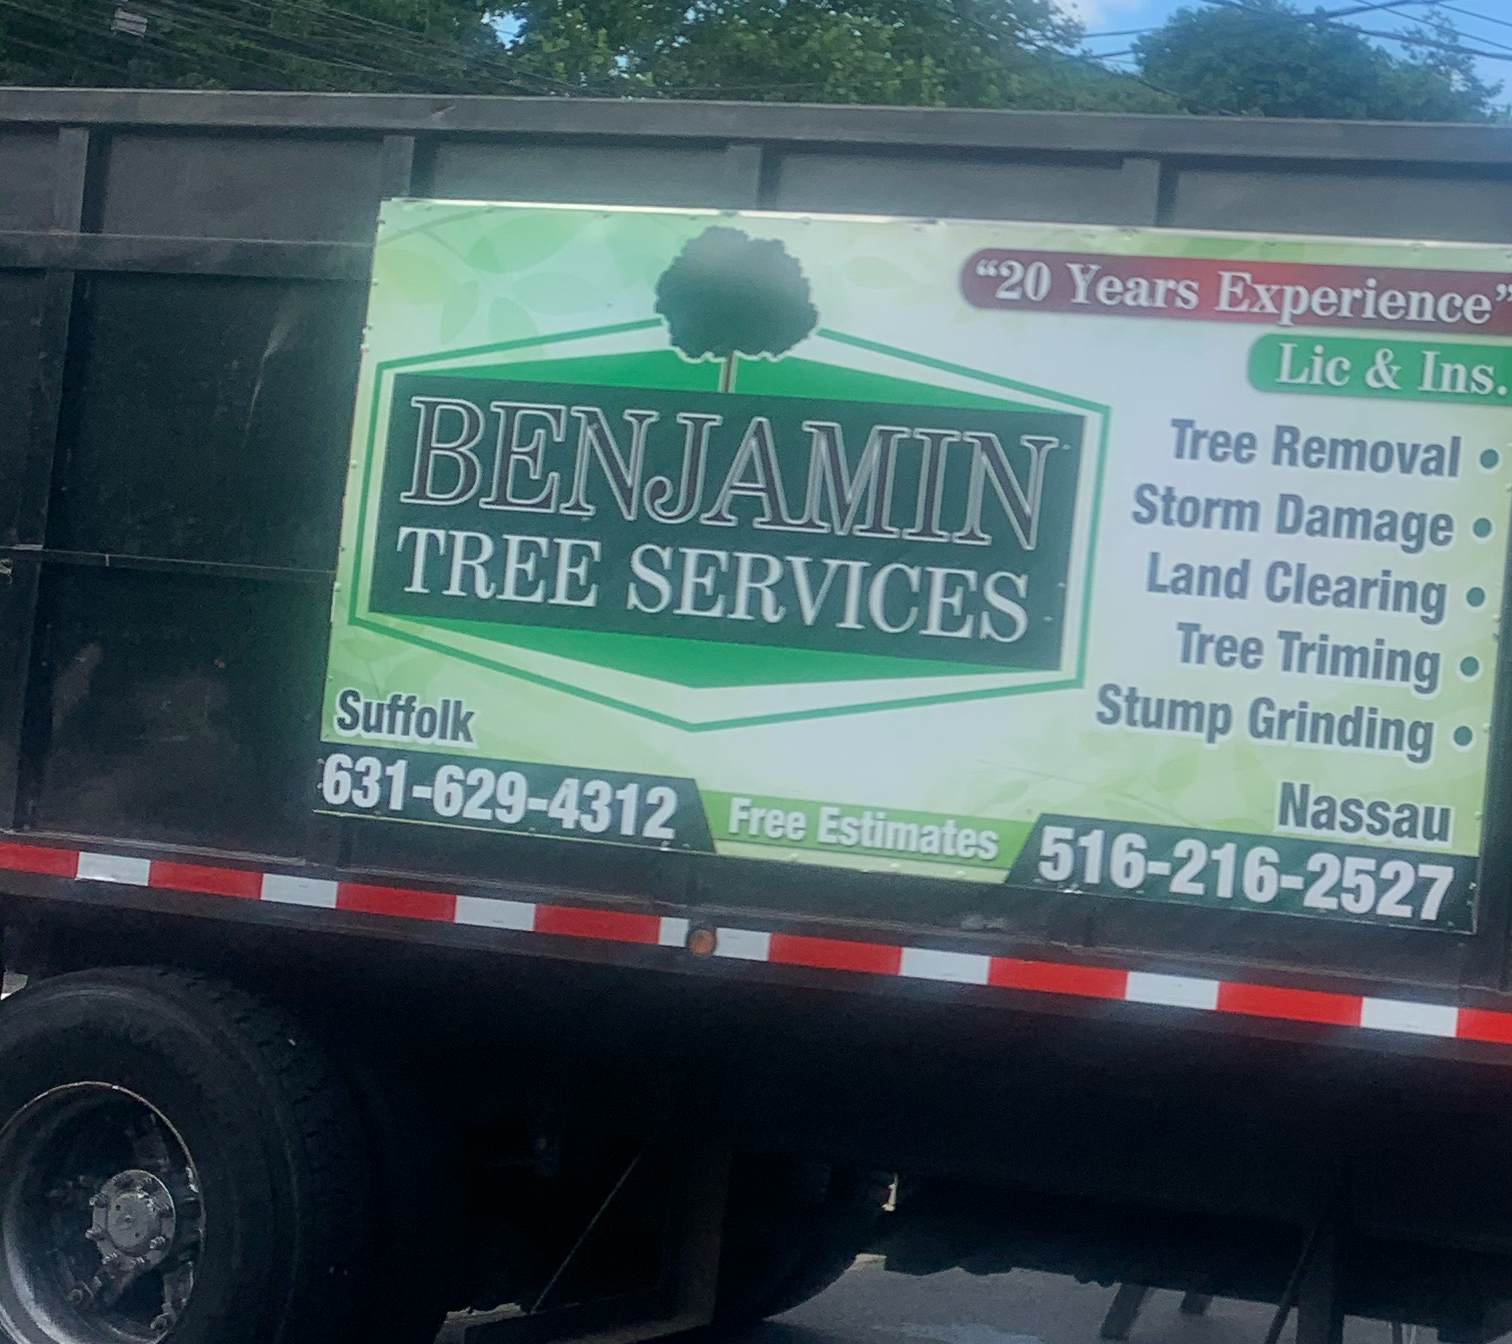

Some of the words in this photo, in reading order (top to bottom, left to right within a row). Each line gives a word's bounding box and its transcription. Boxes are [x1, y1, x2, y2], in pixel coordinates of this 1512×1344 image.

[1066, 262, 1200, 311] Years
[1275, 342, 1351, 387] Lic
[1365, 347, 1403, 390] &
[1417, 350, 1508, 396] Ins.
[399, 395, 1060, 550] BENJAMIN
[1170, 418, 1257, 463] Tree
[1271, 424, 1462, 478] Removal
[1132, 483, 1260, 533] Storm
[1276, 492, 1454, 554] Damage
[396, 525, 600, 608] TREE
[626, 543, 1029, 644] SERVICES
[1146, 551, 1249, 599] Land
[1264, 560, 1447, 624] Clearing
[1176, 622, 1263, 670] Tree
[1277, 629, 1441, 692] Triming
[335, 688, 475, 743] Suffolk
[1095, 683, 1232, 744] Stump
[1248, 696, 1434, 763] Grinding
[321, 752, 679, 840] 631-629-4312
[728, 796, 806, 840] Free
[816, 805, 998, 859] Estimates
[1278, 781, 1451, 842] Nassau
[1038, 825, 1455, 922] 516-216-2527
